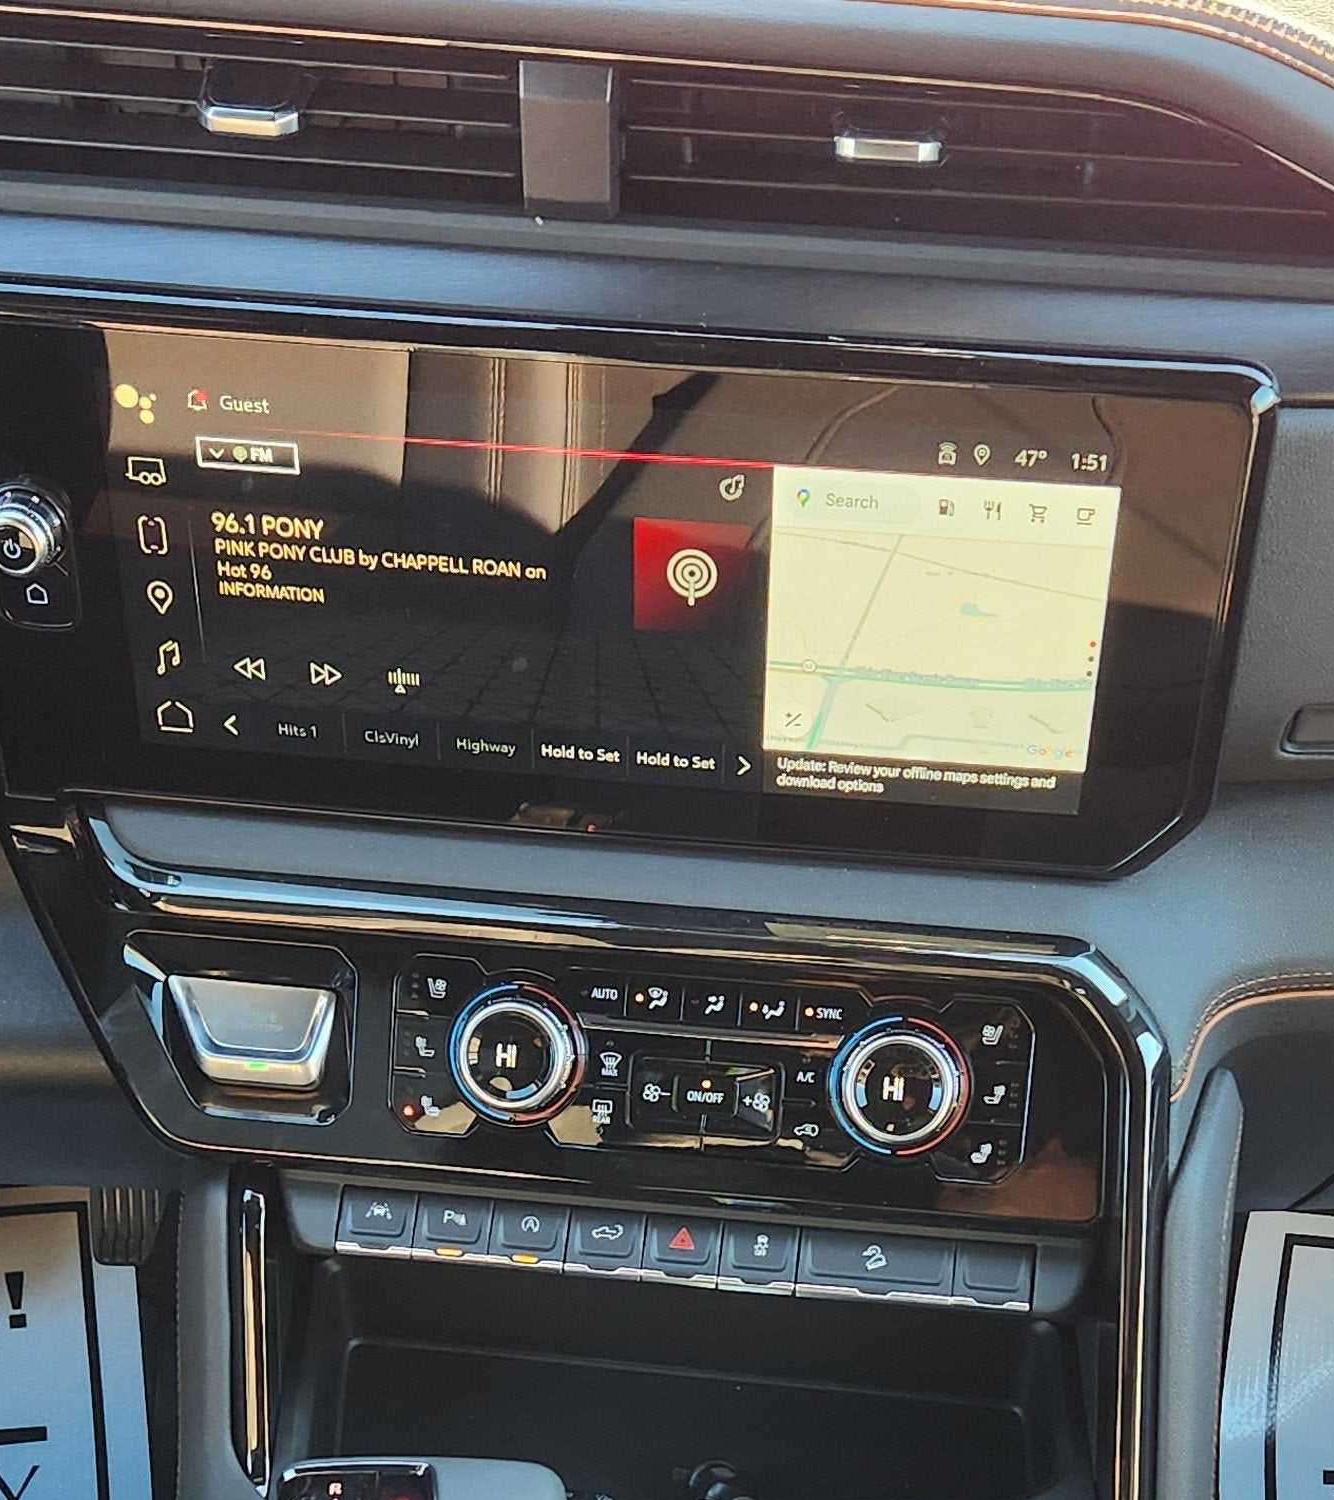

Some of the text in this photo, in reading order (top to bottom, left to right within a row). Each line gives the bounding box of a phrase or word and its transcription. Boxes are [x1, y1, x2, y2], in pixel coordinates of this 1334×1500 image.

[219, 394, 270, 414] Guest
[250, 446, 274, 463] FM
[1071, 452, 1109, 472] 1:51
[825, 492, 879, 510] Search
[211, 510, 324, 541] 96.1 PONY
[215, 537, 547, 580] PINK PONY CLUB by CHAPPELL ROAN on
[217, 559, 273, 581] Hot 96
[219, 580, 325, 604] INFORMATION
[277, 722, 318, 738] Hits 1
[364, 729, 420, 750] ClsVinyl
[455, 737, 517, 757] Highway
[540, 743, 620, 763] Hold to Set
[636, 750, 716, 770] Hold to Set
[777, 756, 1057, 789] Update: Review your offline maps settings and
[776, 773, 885, 794] download options
[591, 987, 618, 1000] AUTO
[816, 1006, 843, 1020] SYNC
[496, 1043, 517, 1068] HI
[796, 1070, 815, 1083] A/C
[686, 1089, 725, 1105] ON/OFF
[882, 1076, 905, 1101] HI
[329, 1482, 342, 1496] R
